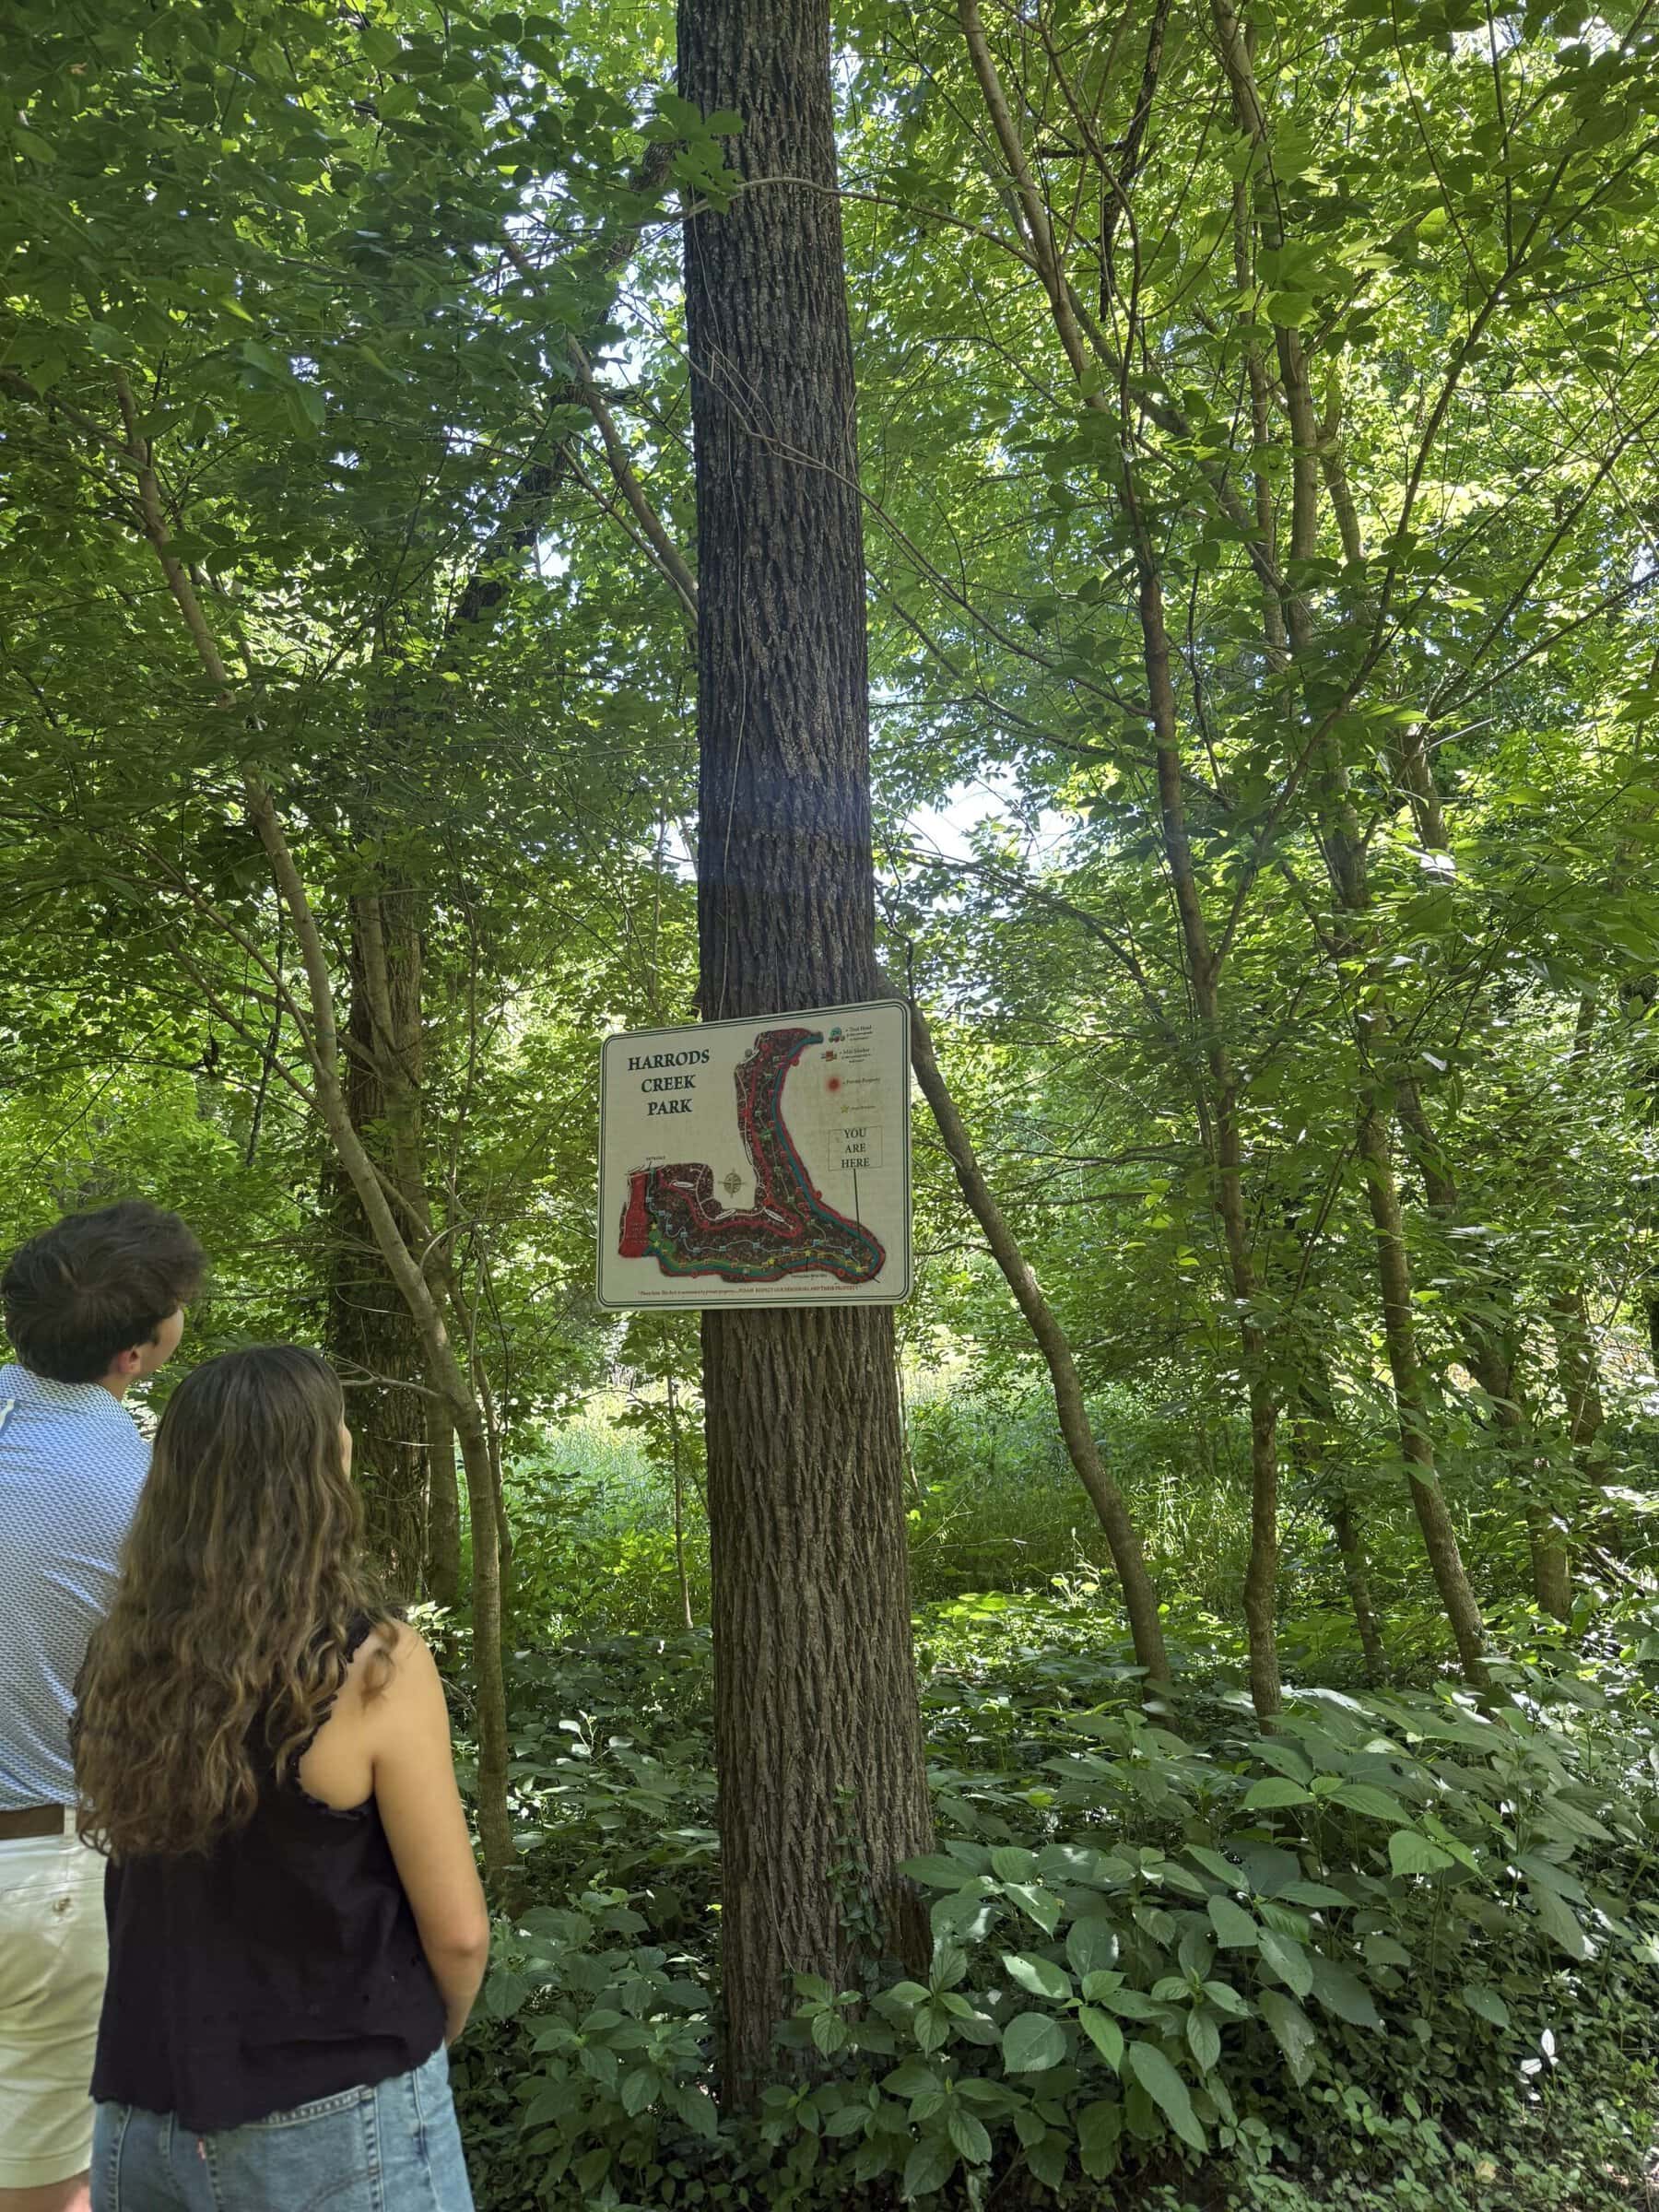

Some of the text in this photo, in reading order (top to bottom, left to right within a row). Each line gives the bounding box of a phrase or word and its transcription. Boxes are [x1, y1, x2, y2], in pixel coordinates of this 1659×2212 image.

[628, 1049, 710, 1070] HARRODS
[641, 1075, 696, 1093] CREEK
[647, 1099, 692, 1116] PARK
[844, 1128, 866, 1138] YOU
[845, 1143, 866, 1153] ARE
[841, 1158, 870, 1168] HERE
